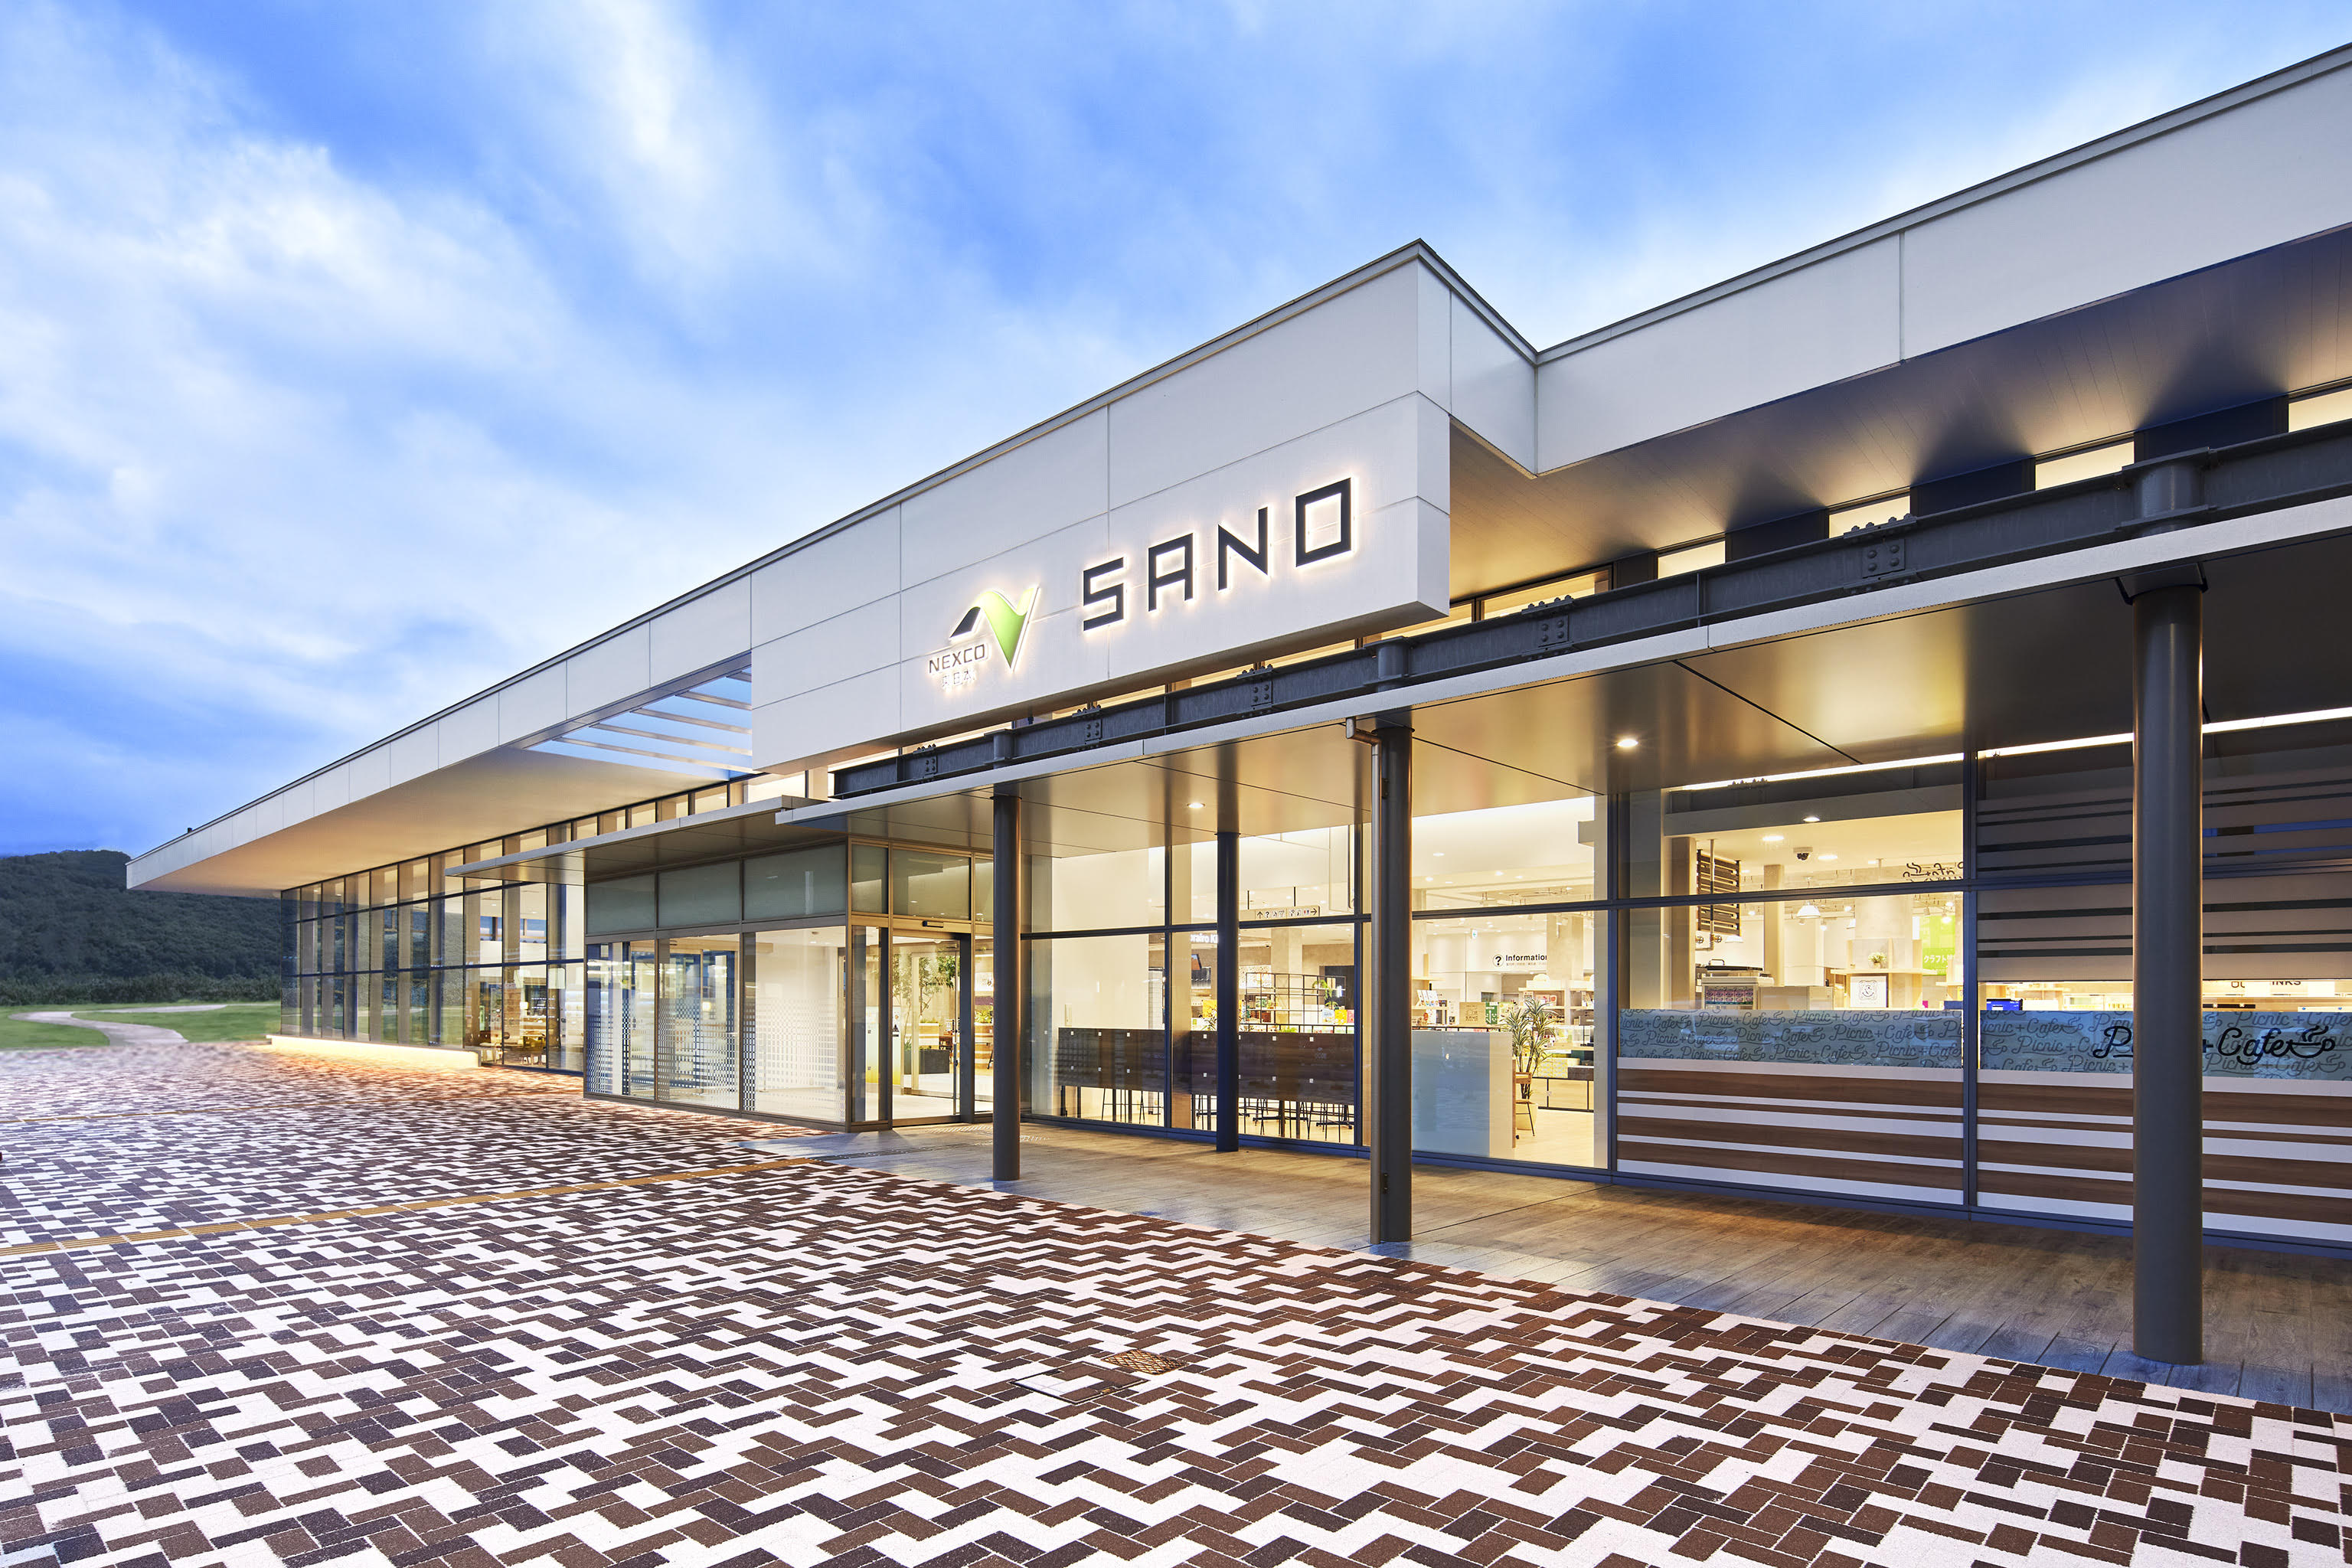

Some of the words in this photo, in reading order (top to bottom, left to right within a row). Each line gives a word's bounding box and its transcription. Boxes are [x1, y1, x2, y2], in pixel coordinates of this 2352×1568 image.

[1083, 477, 1352, 632] SANO
[929, 643, 985, 674] NEXCO
[1620, 1017, 1645, 1031] icnic
[1981, 1019, 2015, 1037] icnic
[2217, 1027, 2288, 1066] Cafe
